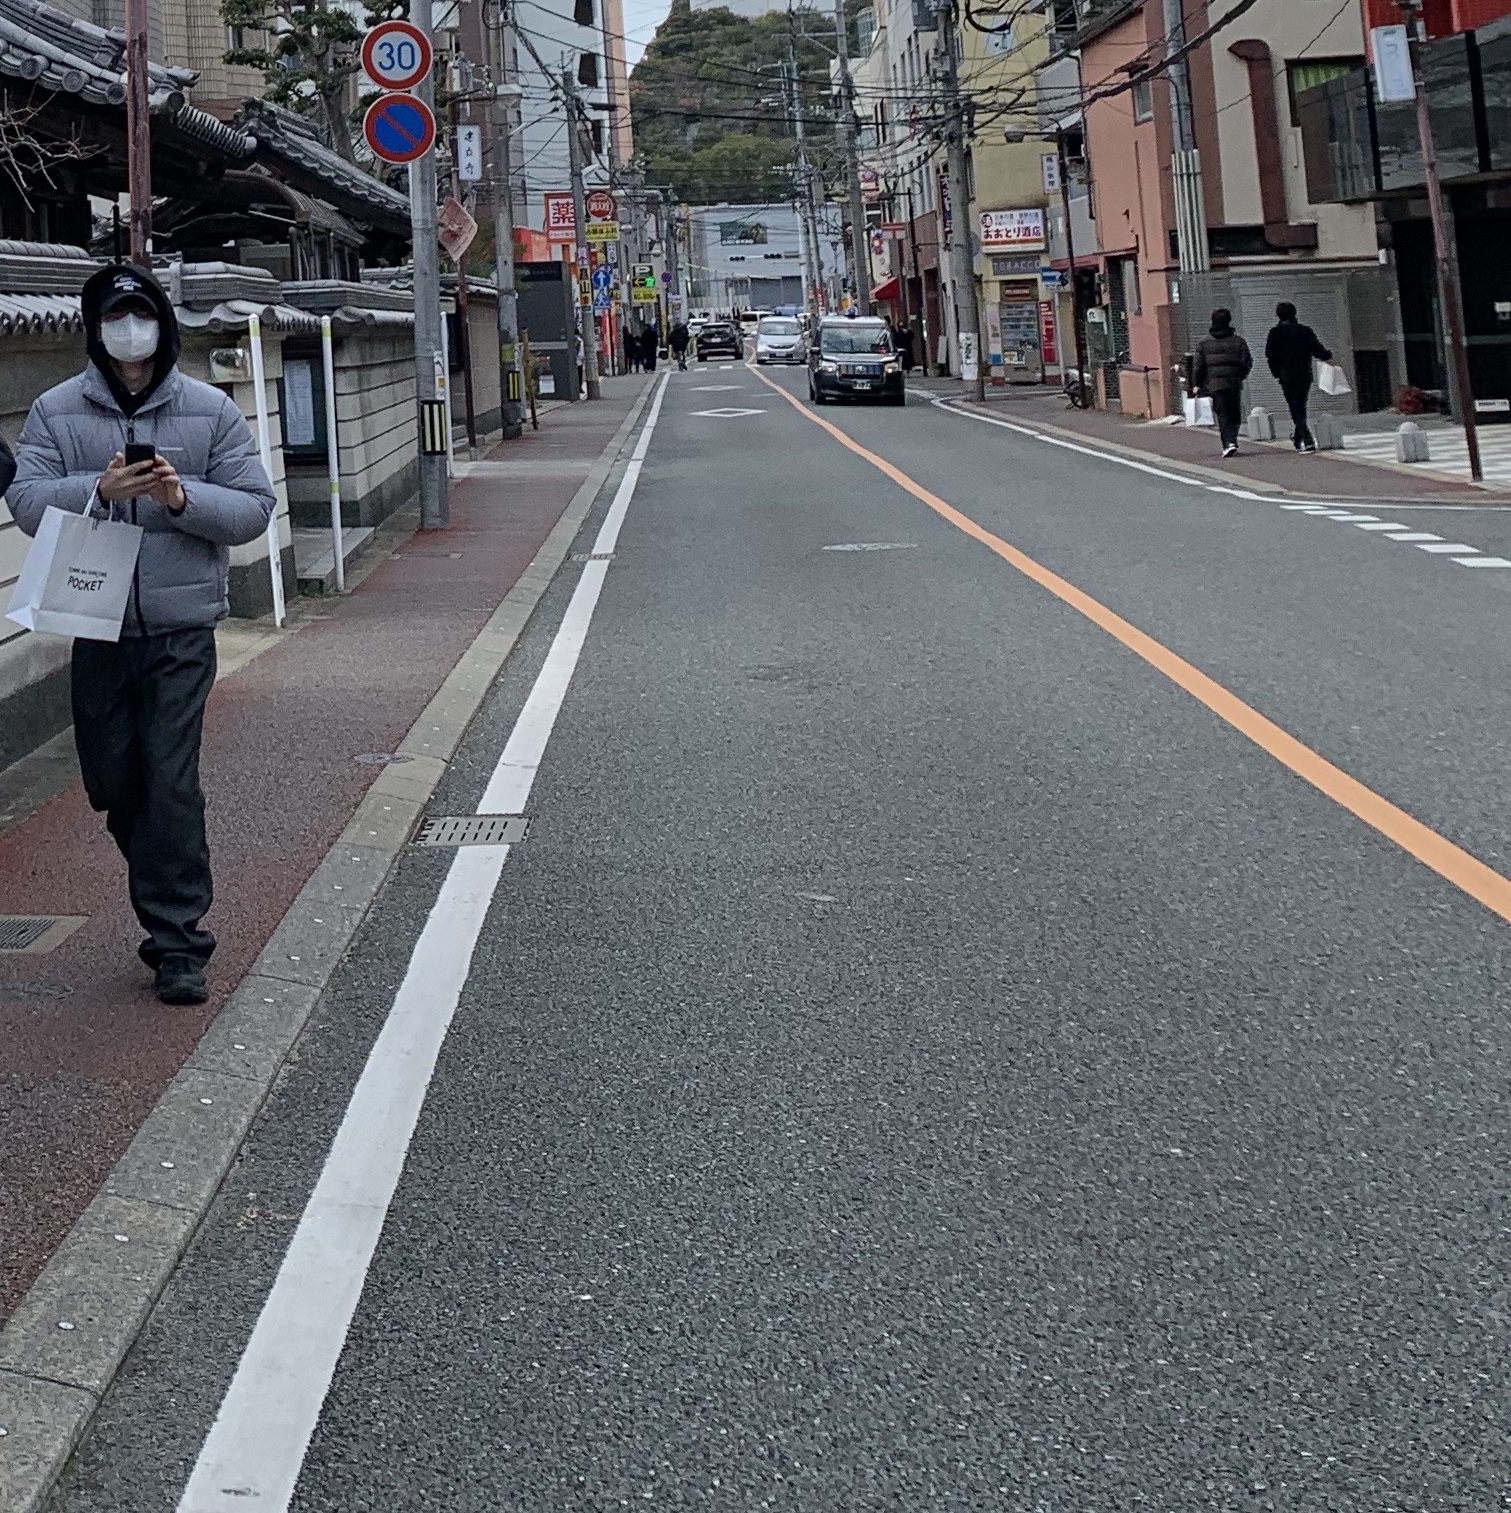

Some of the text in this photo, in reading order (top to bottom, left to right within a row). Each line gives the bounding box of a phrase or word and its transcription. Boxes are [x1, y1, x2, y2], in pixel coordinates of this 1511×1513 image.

[378, 41, 415, 71] 30
[551, 201, 575, 224] 薬
[983, 226, 1041, 239] おおとり酒店
[68, 575, 104, 591] POCKET
